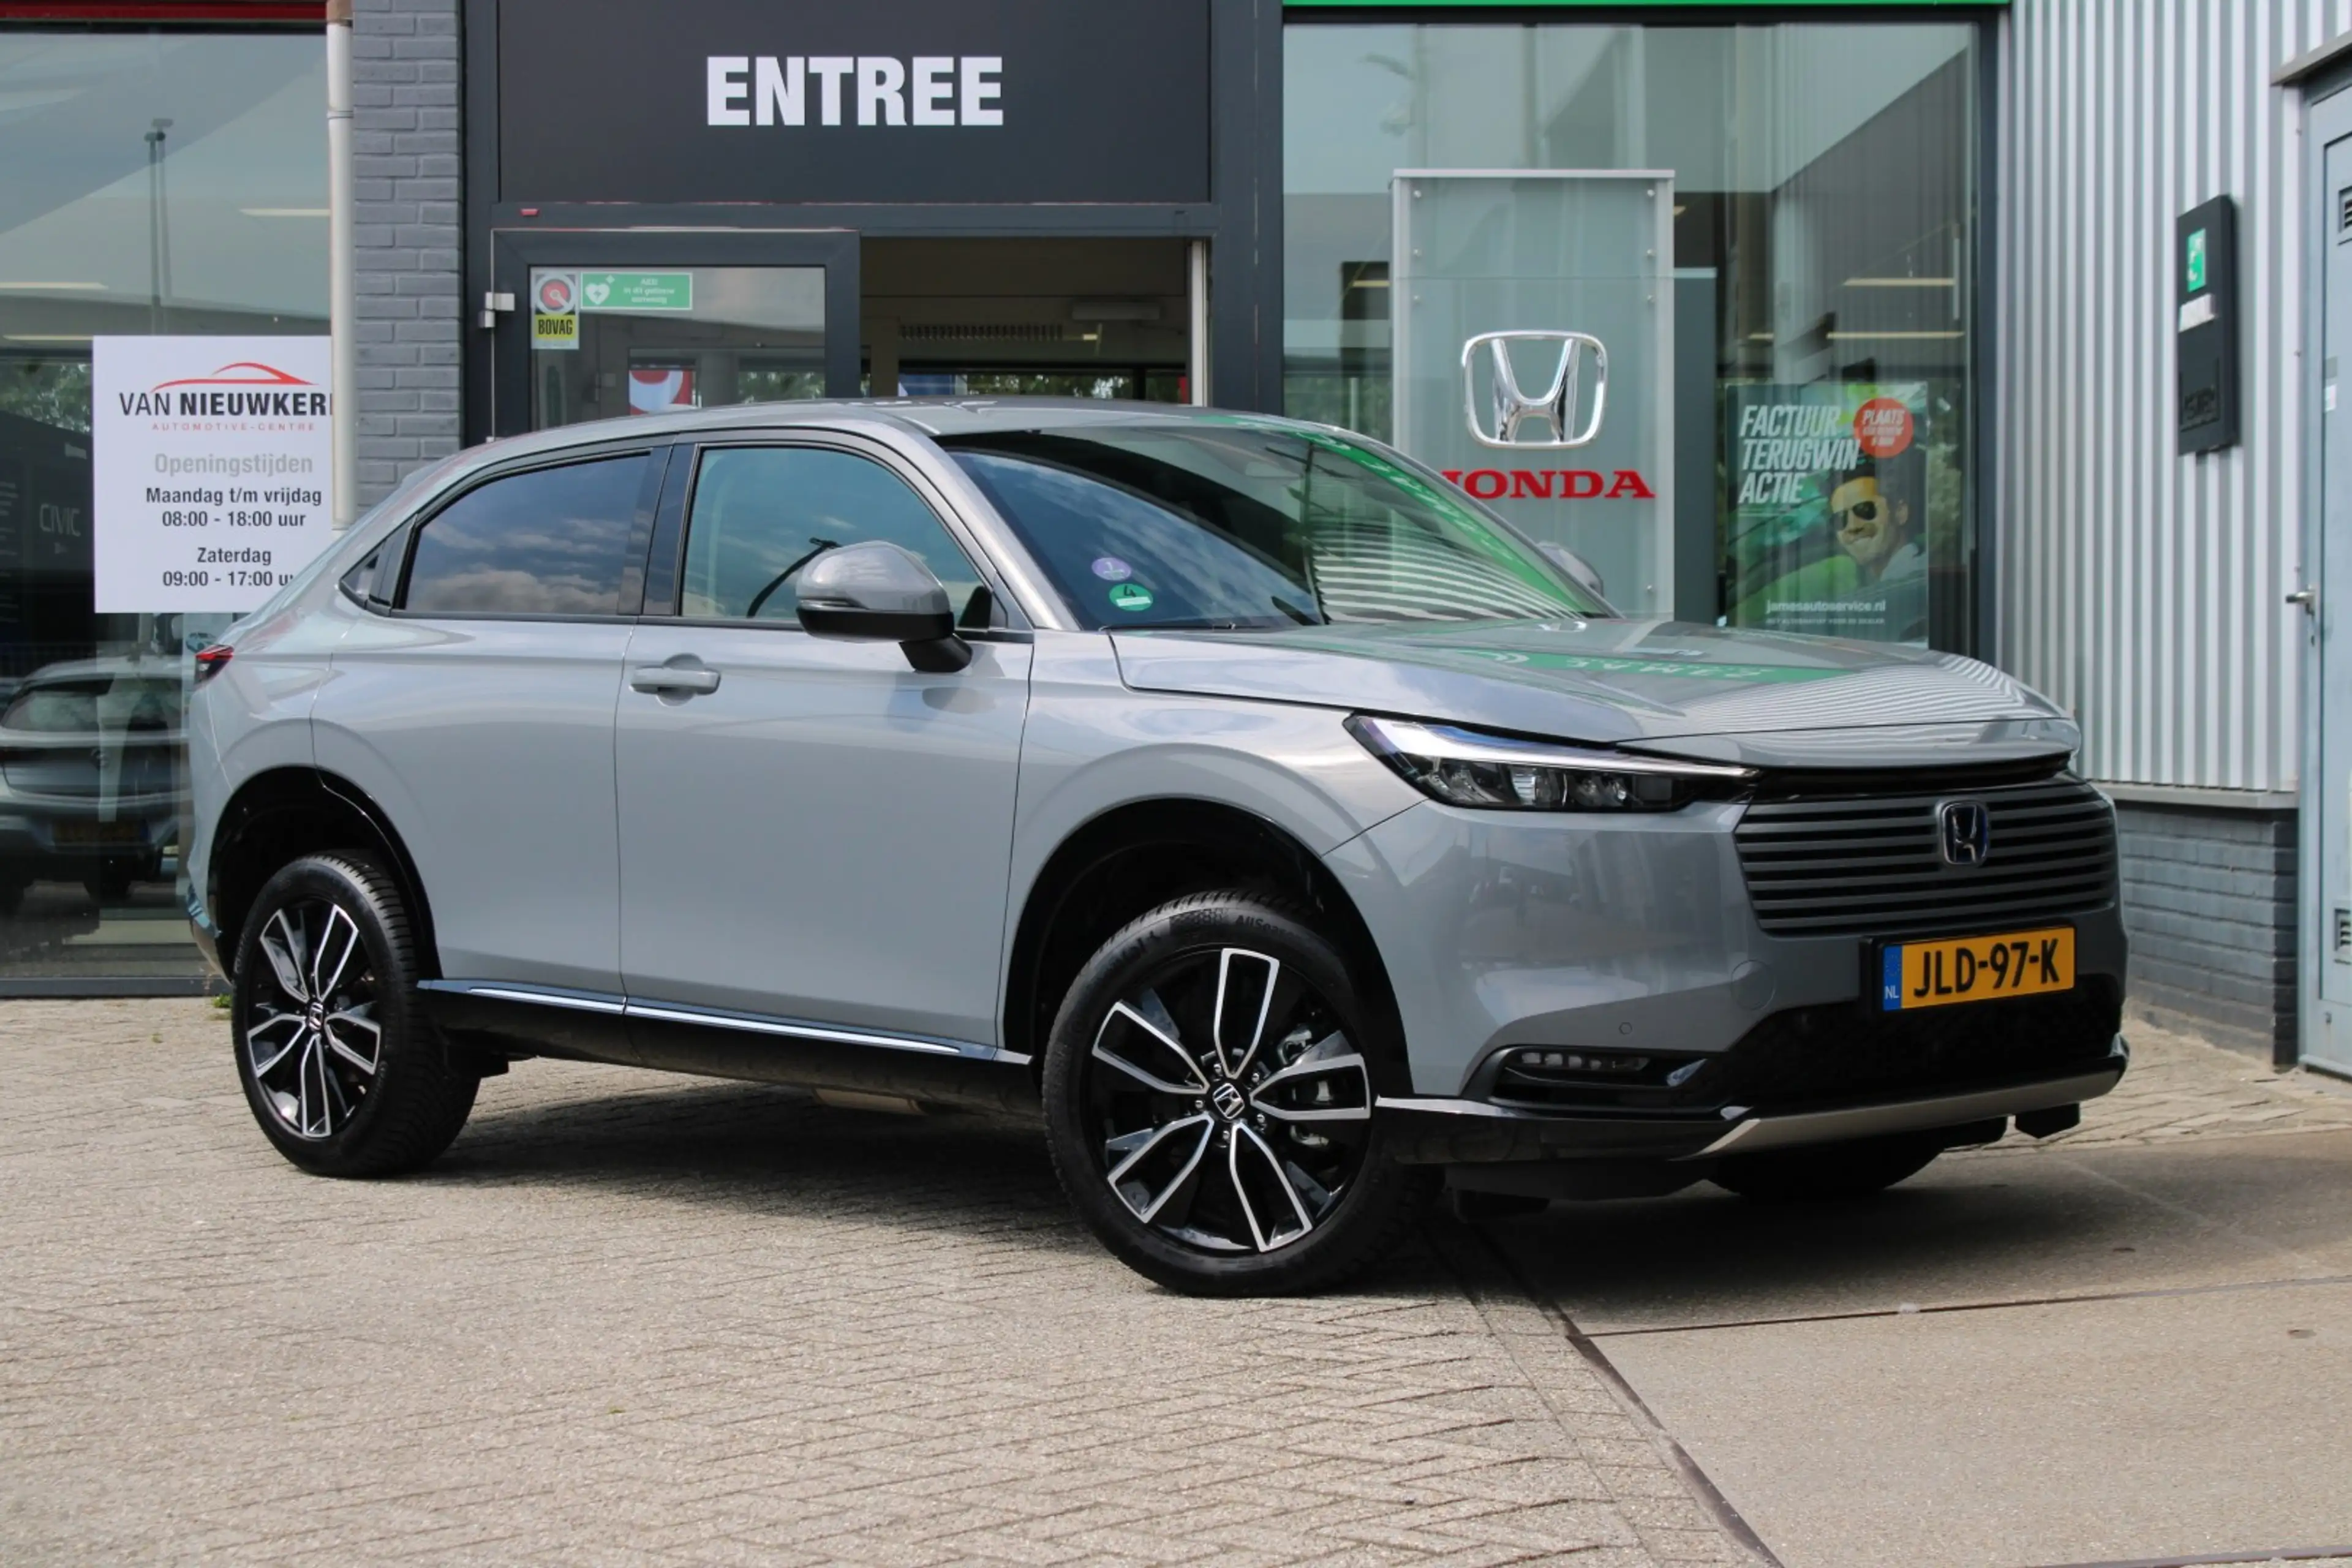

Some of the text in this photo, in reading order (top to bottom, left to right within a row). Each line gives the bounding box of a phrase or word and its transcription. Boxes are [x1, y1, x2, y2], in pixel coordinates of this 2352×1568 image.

[707, 56, 1003, 126] ENTREE
[538, 319, 573, 335] BOVAG
[119, 393, 332, 416] VAN NIEUWKER
[1740, 405, 1841, 437] FACTUUR
[155, 454, 313, 477] Openingstijden
[1743, 439, 1860, 470] TERUGWIN
[146, 488, 322, 506] Maandag t/m vrijdag
[1738, 472, 1806, 503] ACTIE
[162, 511, 208, 526] 08:00
[228, 511, 272, 526] 18:00
[278, 514, 306, 526] uur
[197, 548, 271, 565] Zaterdag
[163, 571, 208, 586] 09:00
[228, 571, 273, 586] 17:00
[1884, 938, 2060, 999] NL JLD-97-K
